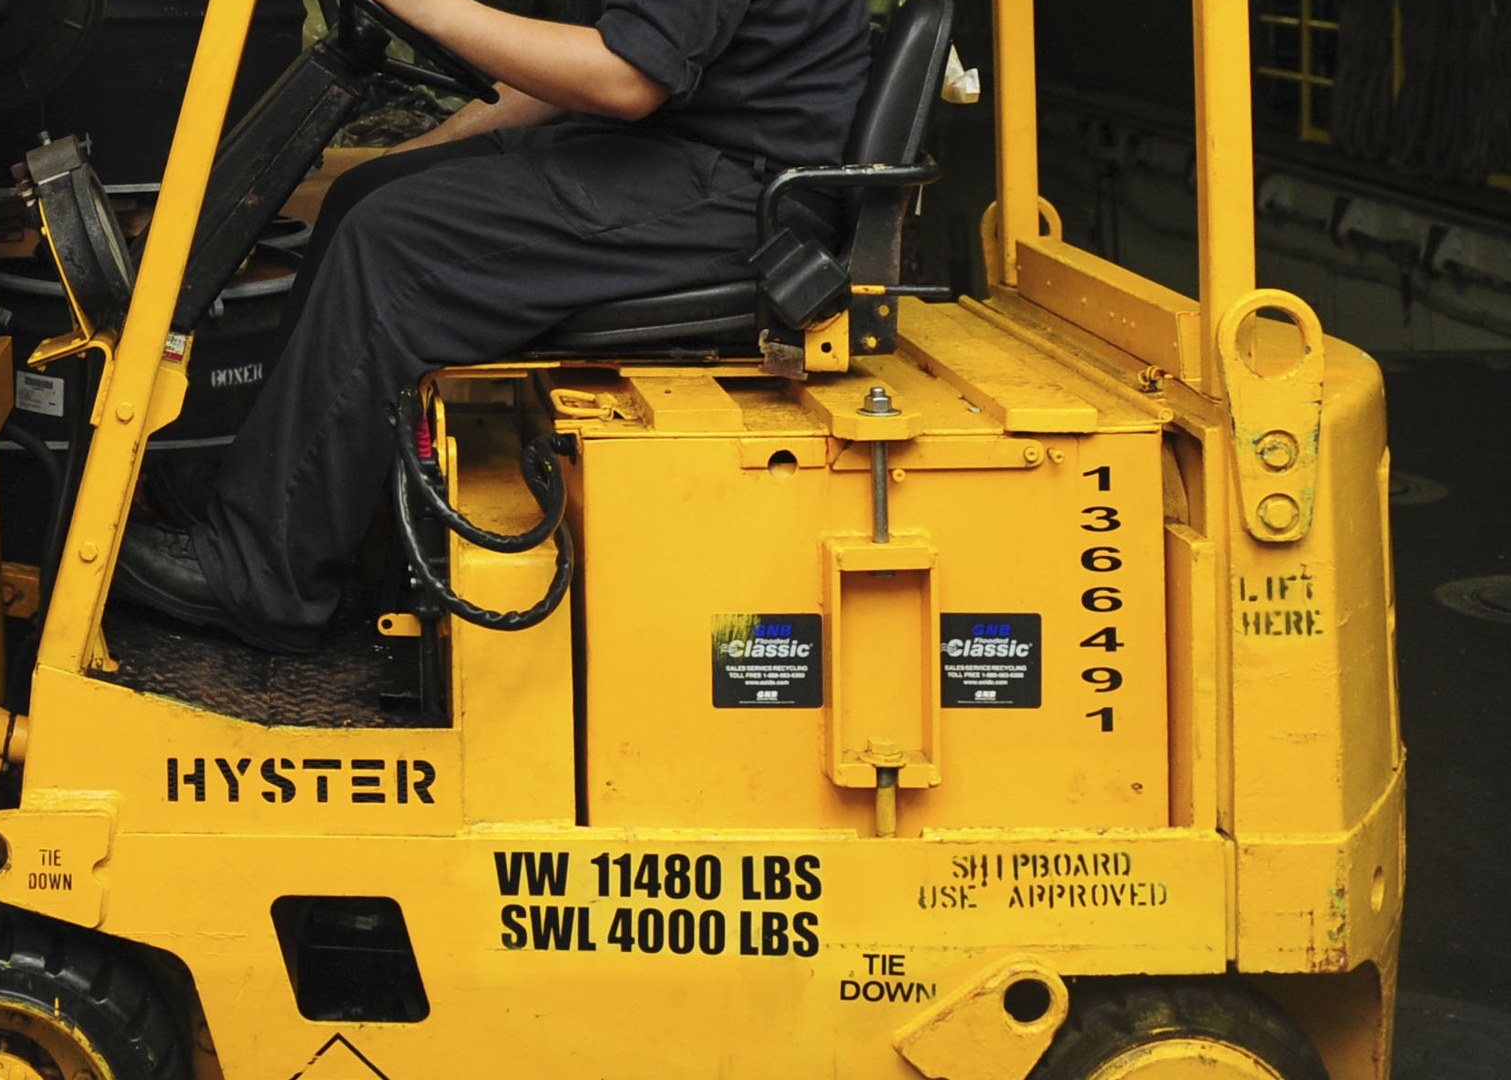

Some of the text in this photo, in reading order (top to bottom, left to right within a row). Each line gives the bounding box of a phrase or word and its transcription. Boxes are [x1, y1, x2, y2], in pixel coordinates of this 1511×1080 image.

[211, 363, 263, 387] BOXER
[1237, 573, 1315, 602] LIFT
[753, 624, 792, 637] GNB
[972, 624, 1012, 637] GNB
[1242, 610, 1324, 636] HERE
[729, 639, 810, 657] Classic
[947, 639, 1029, 657] Classic
[166, 757, 436, 805] HYSTER
[38, 848, 62, 867] TIE
[951, 852, 1132, 882] SHIPBOARD
[28, 871, 73, 891] DOWN
[493, 851, 823, 902] VW 11480 LBS
[917, 883, 1169, 910] USE APPROVED
[500, 904, 821, 958] SWL 4000 LBS
[862, 953, 906, 976] TIE
[839, 980, 938, 1003] DOWN
